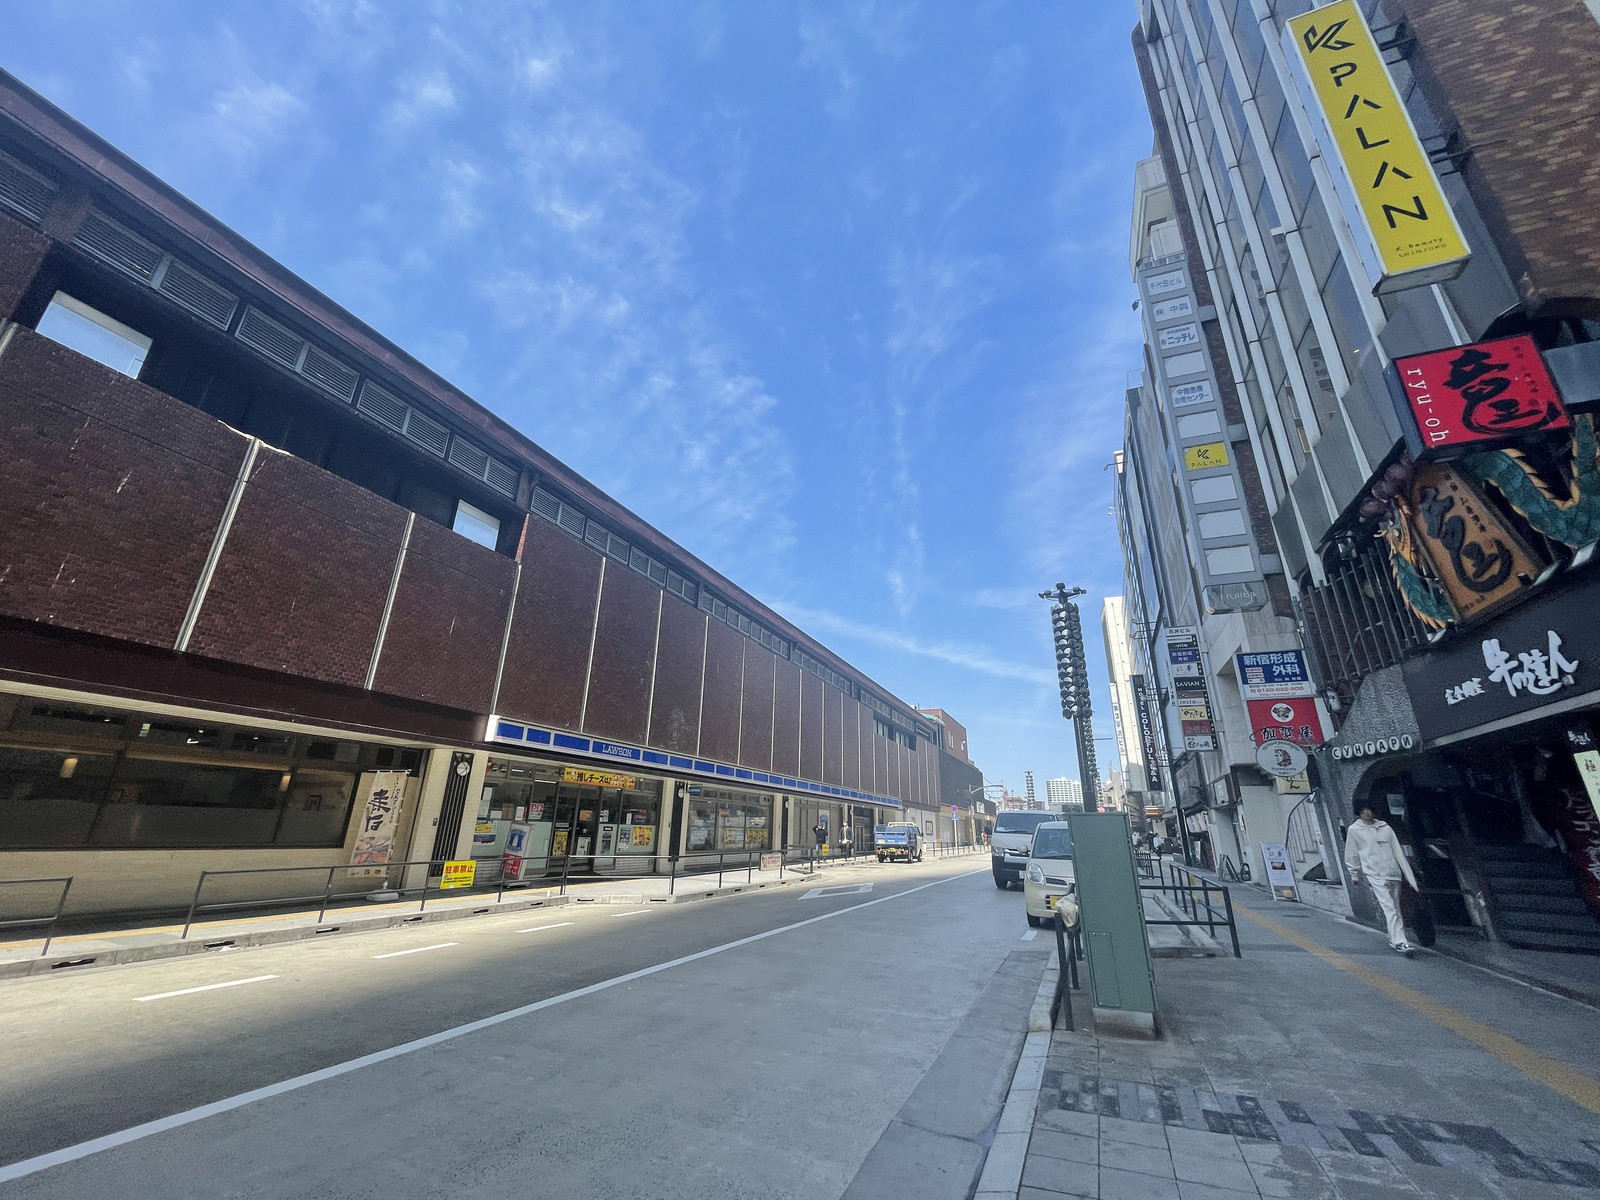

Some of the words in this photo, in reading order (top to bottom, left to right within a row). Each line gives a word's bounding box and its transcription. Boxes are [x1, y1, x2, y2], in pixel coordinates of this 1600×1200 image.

[1329, 62, 1429, 228] PALAN
[1167, 332, 1196, 346] ニッテレ
[1407, 367, 1450, 442] ryu-oh
[1191, 459, 1222, 467] PALAN
[1243, 651, 1297, 666] 新宿形成
[1481, 630, 1579, 697] 牛の達人
[1272, 663, 1300, 676] 外科
[1261, 725, 1314, 740] 加賀屋
[602, 744, 633, 757] LAWSON
[1333, 735, 1412, 759] СУНГАРИ
[444, 864, 473, 874] 駐車禁止
